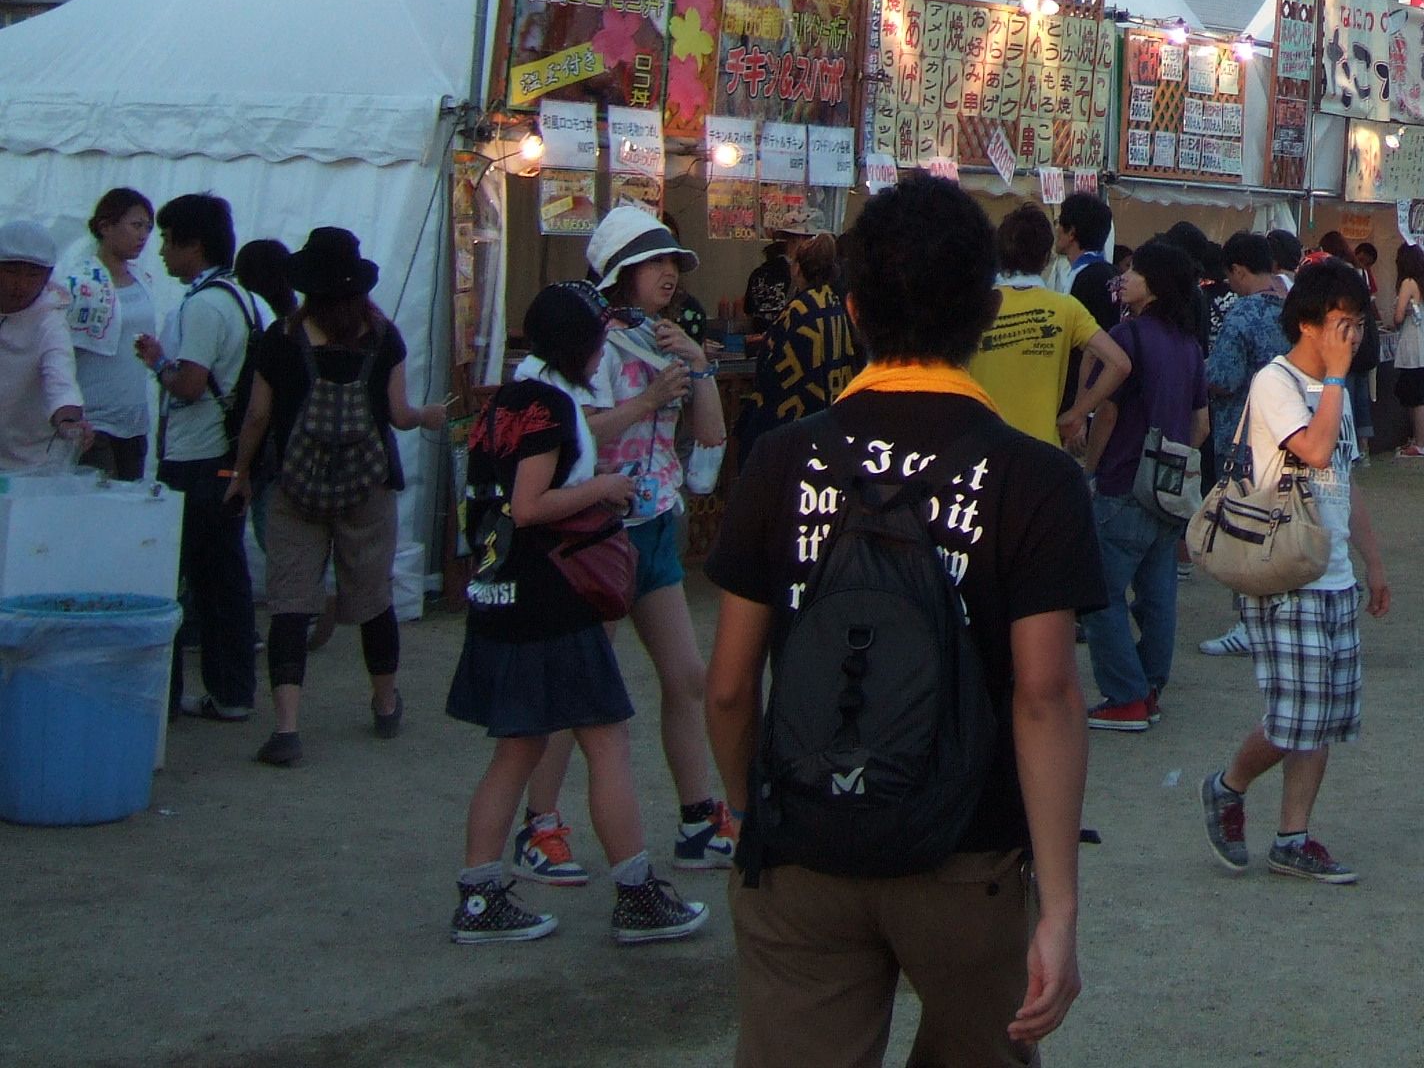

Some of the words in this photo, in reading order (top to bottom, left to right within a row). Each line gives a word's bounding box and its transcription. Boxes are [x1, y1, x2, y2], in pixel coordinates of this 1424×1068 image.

[982, 18, 1007, 113] からあげ
[1001, 19, 1026, 116] フランク
[1036, 21, 1061, 165] とうもろこし
[796, 523, 832, 564] it'
[946, 493, 984, 545] it,
